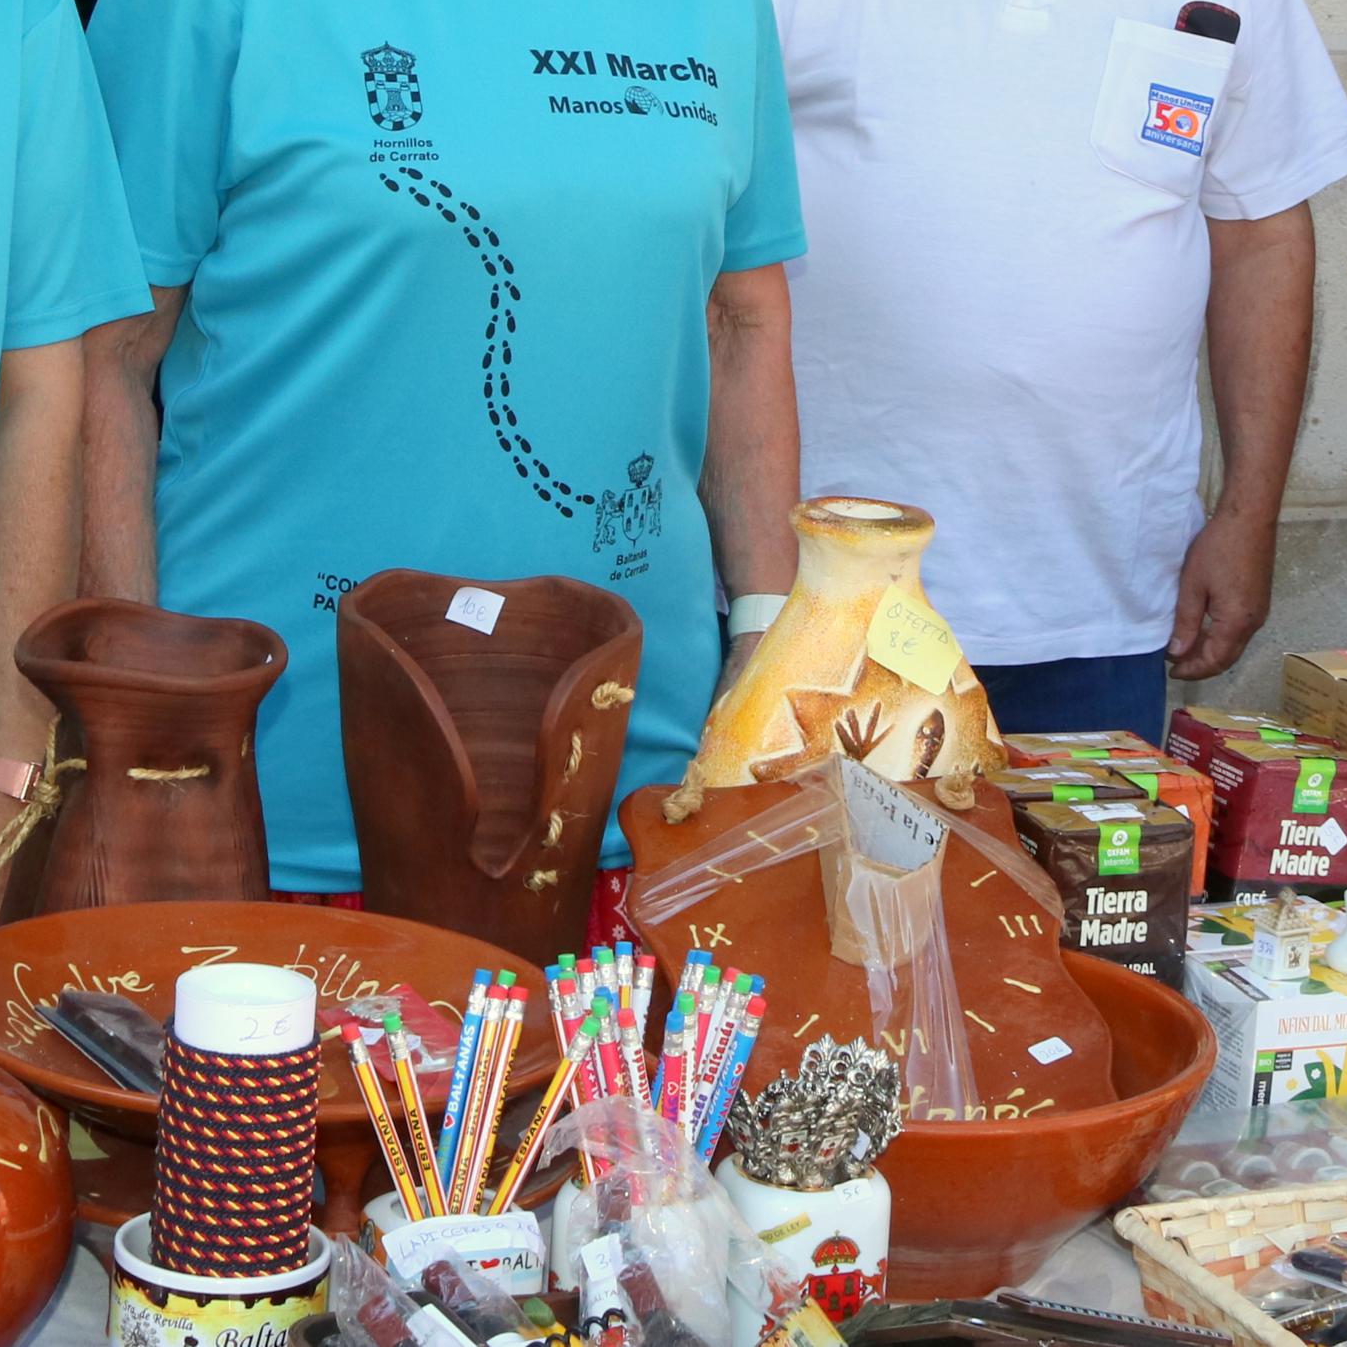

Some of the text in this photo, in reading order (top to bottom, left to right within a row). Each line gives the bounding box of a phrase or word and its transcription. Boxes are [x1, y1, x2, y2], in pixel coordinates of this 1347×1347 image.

[530, 49, 717, 89] XXI Marcha
[549, 95, 718, 127] Manos Unidas
[1151, 91, 1212, 114] Manos Unidas
[1153, 102, 1199, 139] 50
[373, 138, 433, 149] Hornillos
[1144, 129, 1201, 152] aniversario
[370, 151, 439, 163] de Cerrato
[1107, 847, 1131, 857] OXFAM
[1269, 848, 1330, 877] Madre
[1085, 887, 1148, 915] Tierra
[689, 924, 732, 947] IX
[999, 914, 1043, 937] III
[1080, 920, 1148, 947] Madre
[880, 1028, 928, 1056] VI
[449, 1024, 476, 1114] BALTANÁS
